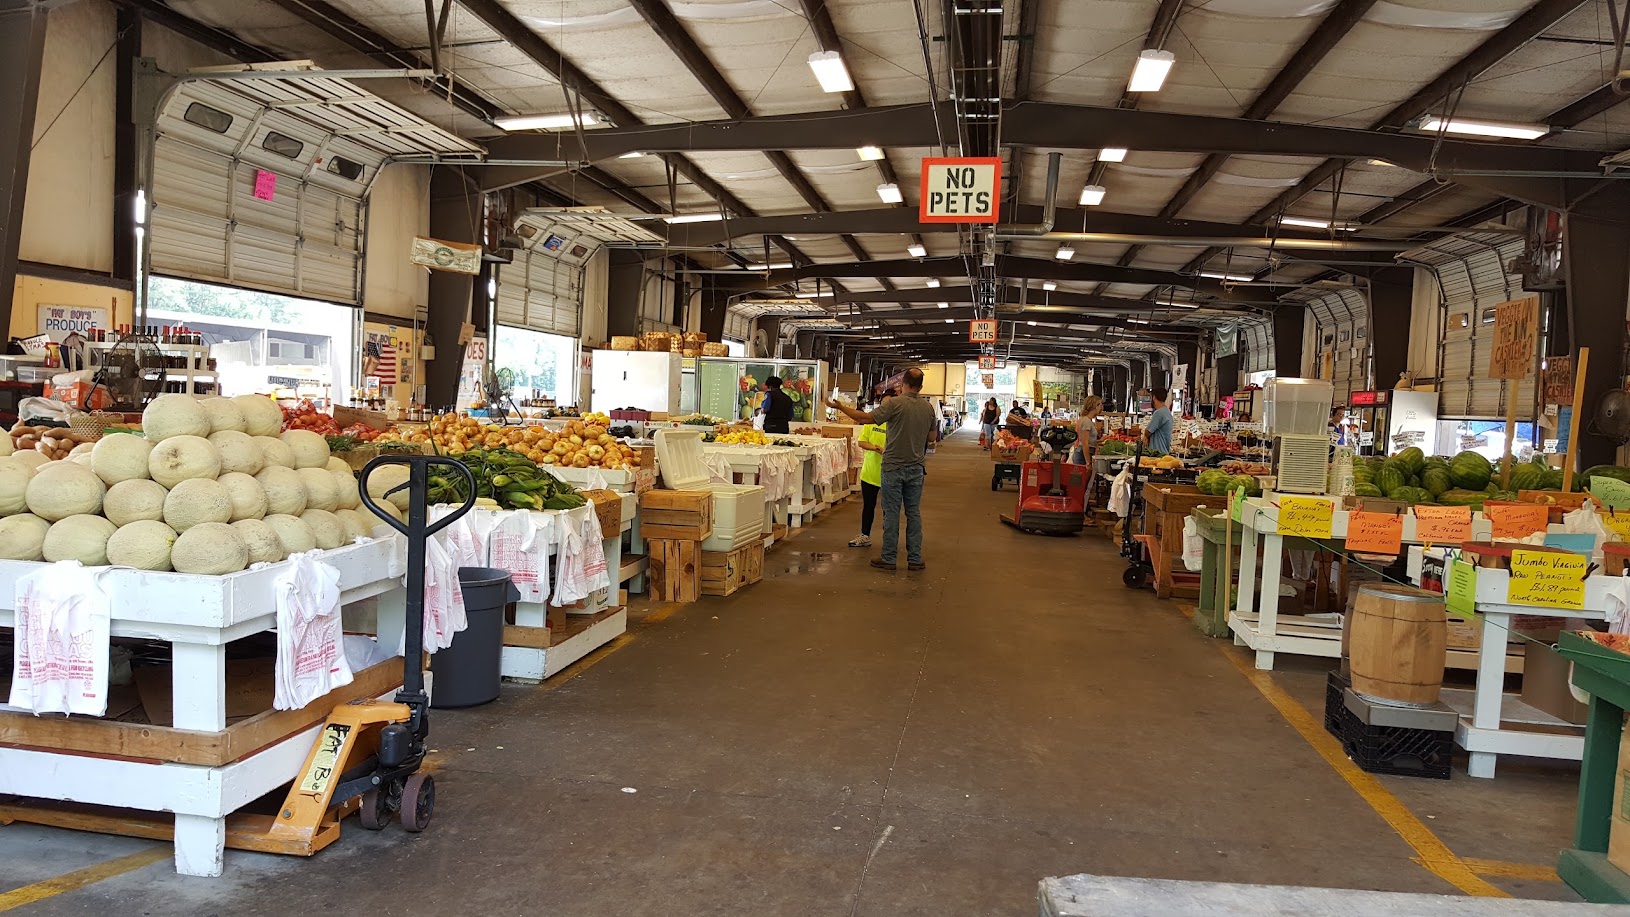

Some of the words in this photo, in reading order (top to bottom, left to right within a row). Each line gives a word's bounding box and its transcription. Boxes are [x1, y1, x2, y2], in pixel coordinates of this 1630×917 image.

[946, 167, 975, 189] NO
[930, 191, 990, 213] PETS
[46, 319, 97, 332] PRODUCE
[977, 322, 989, 330] NO
[972, 331, 994, 340] PETS
[1514, 553, 1548, 566] Jumbo
[322, 723, 351, 757] FAT
